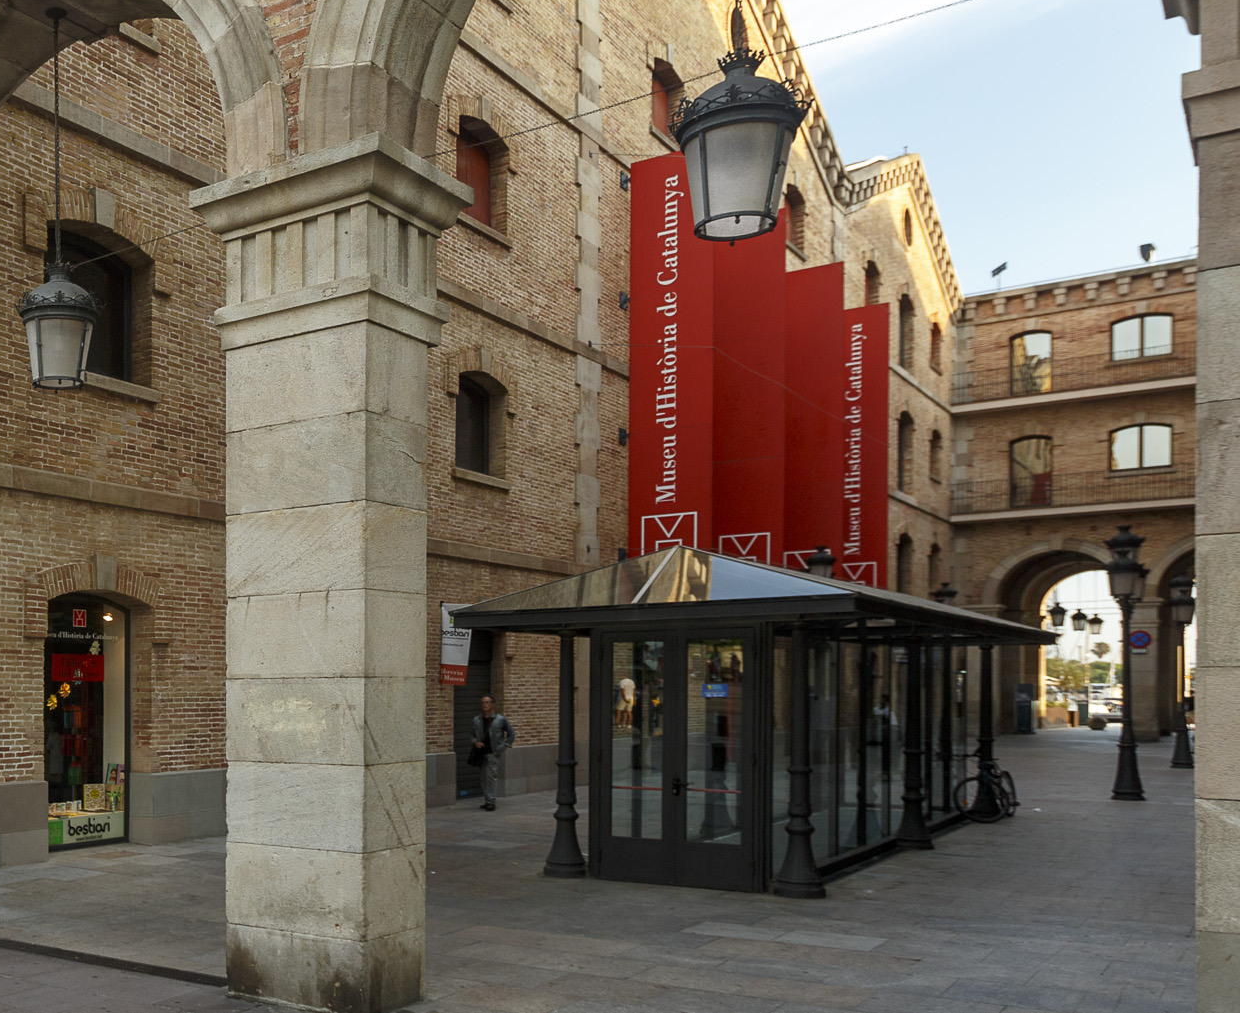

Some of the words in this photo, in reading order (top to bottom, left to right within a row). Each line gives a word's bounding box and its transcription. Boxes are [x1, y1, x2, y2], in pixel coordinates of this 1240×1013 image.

[656, 174, 685, 286] Catalunya
[656, 291, 678, 317] de
[655, 323, 678, 429] d'Història
[844, 323, 868, 402] Catalunya
[844, 406, 862, 424] de
[655, 434, 677, 505] Museu
[843, 428, 861, 503] d'Història
[844, 508, 861, 555] Museu
[68, 816, 111, 837] bestiari
